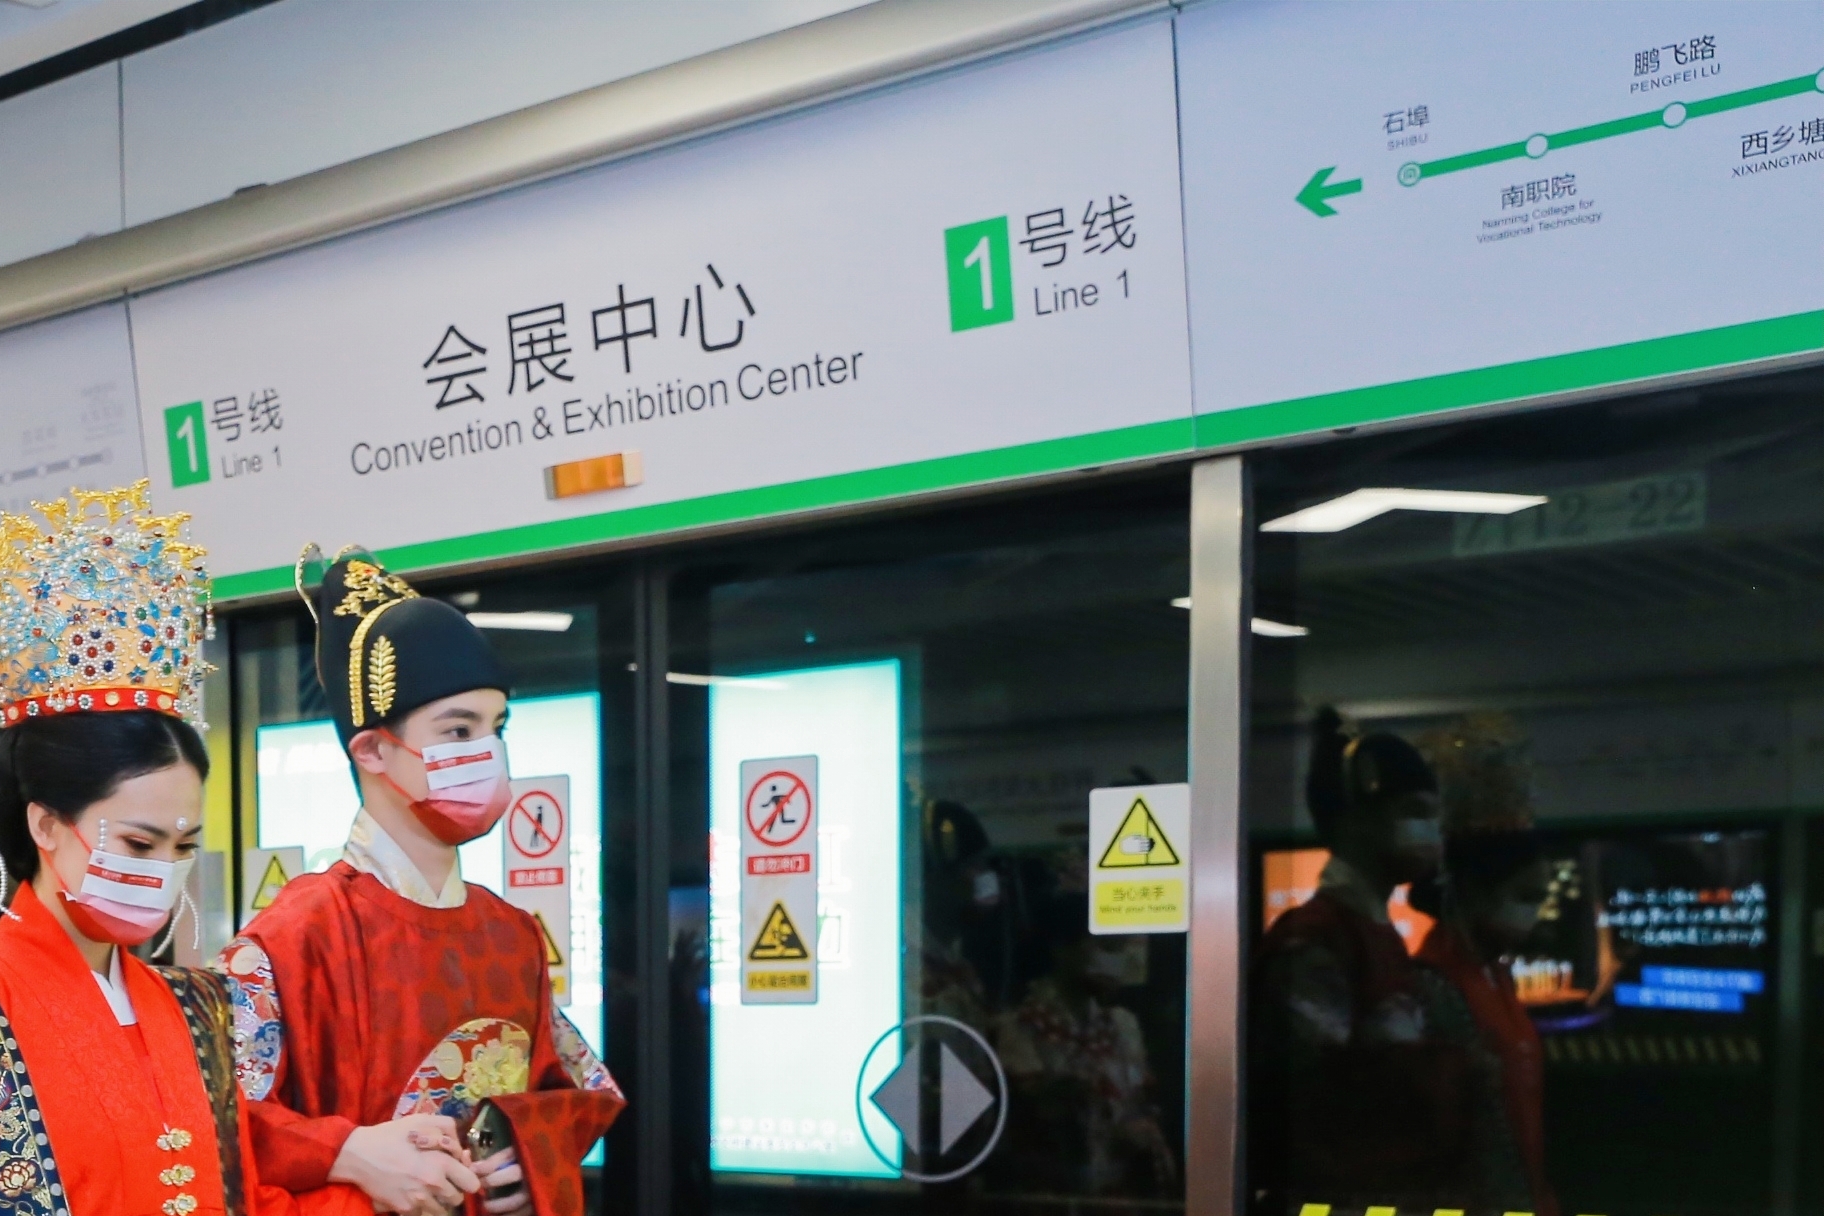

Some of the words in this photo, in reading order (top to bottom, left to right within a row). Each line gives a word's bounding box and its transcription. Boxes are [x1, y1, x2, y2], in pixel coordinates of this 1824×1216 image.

[1633, 34, 1717, 77] 鹏飞路
[1629, 68, 1697, 94] PENGFEI
[1701, 63, 1721, 78] LU
[1382, 104, 1430, 135] 石埠
[1386, 132, 1429, 151] SHIBU
[1740, 117, 1824, 160] 西乡塘
[1500, 172, 1577, 210] 南职院
[1476, 224, 1533, 244] Vocational
[1538, 209, 1603, 233] Technology
[1482, 210, 1529, 230] Nanning
[1531, 202, 1575, 222] College
[1578, 199, 1595, 212] for
[1034, 282, 1099, 316] Line
[1116, 269, 1130, 299] 1
[422, 263, 756, 410] 会展中心
[350, 418, 523, 475] Convention
[532, 405, 554, 441] &
[563, 377, 729, 436] Exhibition
[737, 352, 864, 400] Center
[221, 452, 263, 479] Line
[273, 445, 282, 467] 1
